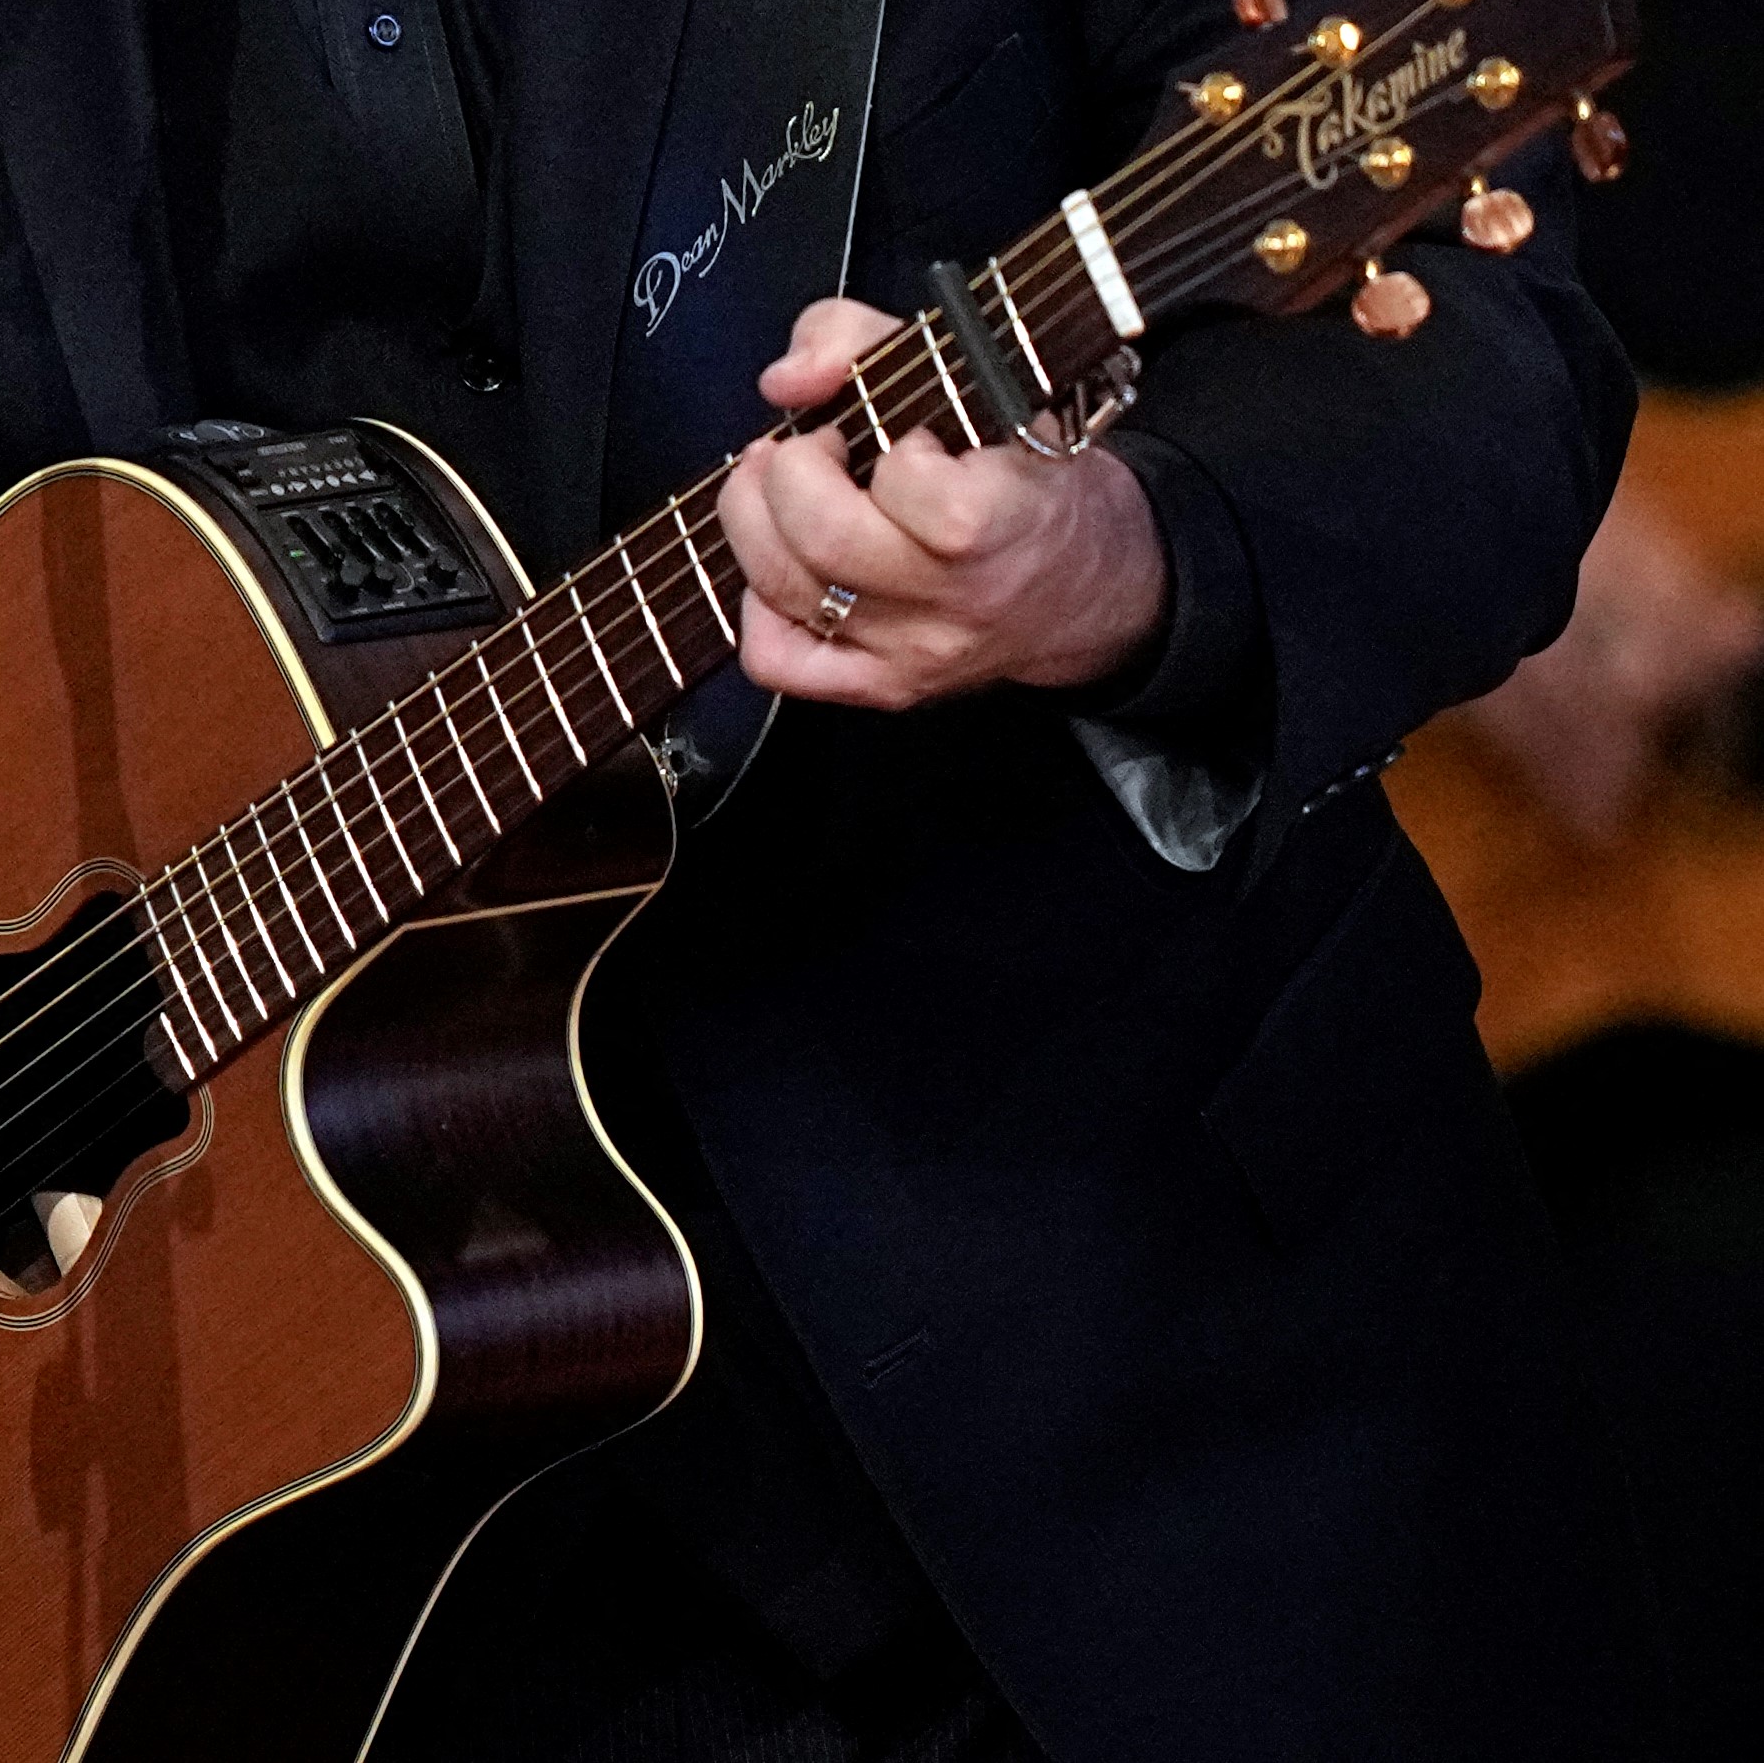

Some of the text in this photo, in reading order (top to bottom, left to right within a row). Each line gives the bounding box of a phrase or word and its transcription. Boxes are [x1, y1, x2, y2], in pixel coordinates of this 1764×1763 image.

[1260, 26, 1470, 190] Takamine
[633, 100, 840, 338] Dean Markley
